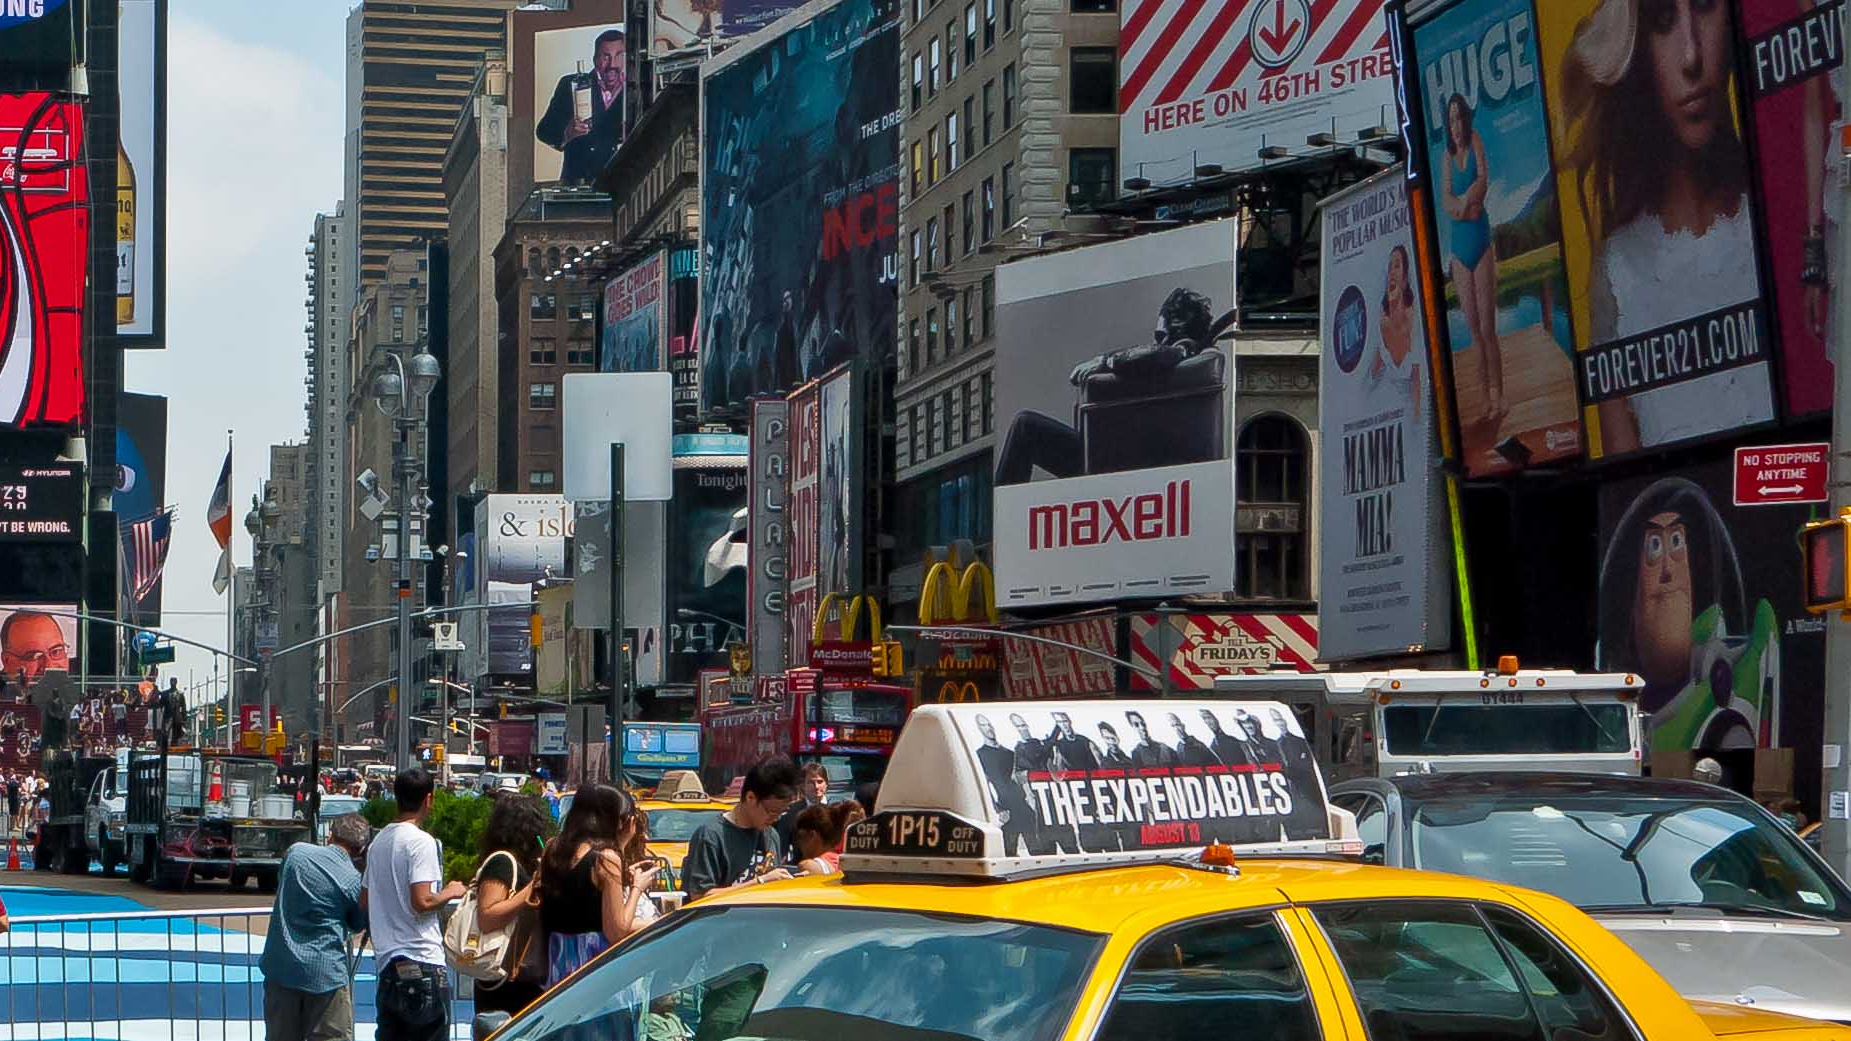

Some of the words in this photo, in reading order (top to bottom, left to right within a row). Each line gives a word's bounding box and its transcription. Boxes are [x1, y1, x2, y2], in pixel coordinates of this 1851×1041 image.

[1426, 10, 1533, 130] HUGE
[1144, 99, 1205, 134] HERE
[1214, 89, 1247, 117] ON
[1258, 72, 1320, 105] 46TH
[860, 118, 879, 140] THE
[823, 186, 845, 205] FROM
[1332, 220, 1376, 257] POPULAR
[607, 279, 626, 305] THE
[627, 258, 661, 292] CROWD
[608, 299, 633, 325] GOES
[1585, 308, 1760, 397] FOREVER21.COM
[1343, 422, 1405, 497] MAMMA
[1743, 455, 1760, 466] NO
[1764, 452, 1821, 465] STOPPING
[697, 473, 748, 489] Tonight
[1756, 468, 1808, 481] ANYTIME
[11, 521, 25, 534] BE
[28, 521, 71, 534] WRONG.
[500, 511, 528, 537] &
[764, 418, 787, 612] PALACE
[1028, 479, 1191, 551] maxell
[1355, 491, 1392, 559] MIA!
[1199, 643, 1271, 661] FRIDAY'S
[1029, 779, 1093, 826] THE
[1095, 771, 1293, 825] EXPENDABLES
[850, 836, 880, 849] DUTY
[856, 823, 879, 836] OFF
[888, 815, 940, 847] 1P15
[952, 826, 974, 840] OFF
[1140, 823, 1184, 846] AUGUST
[947, 840, 979, 853] DUTY
